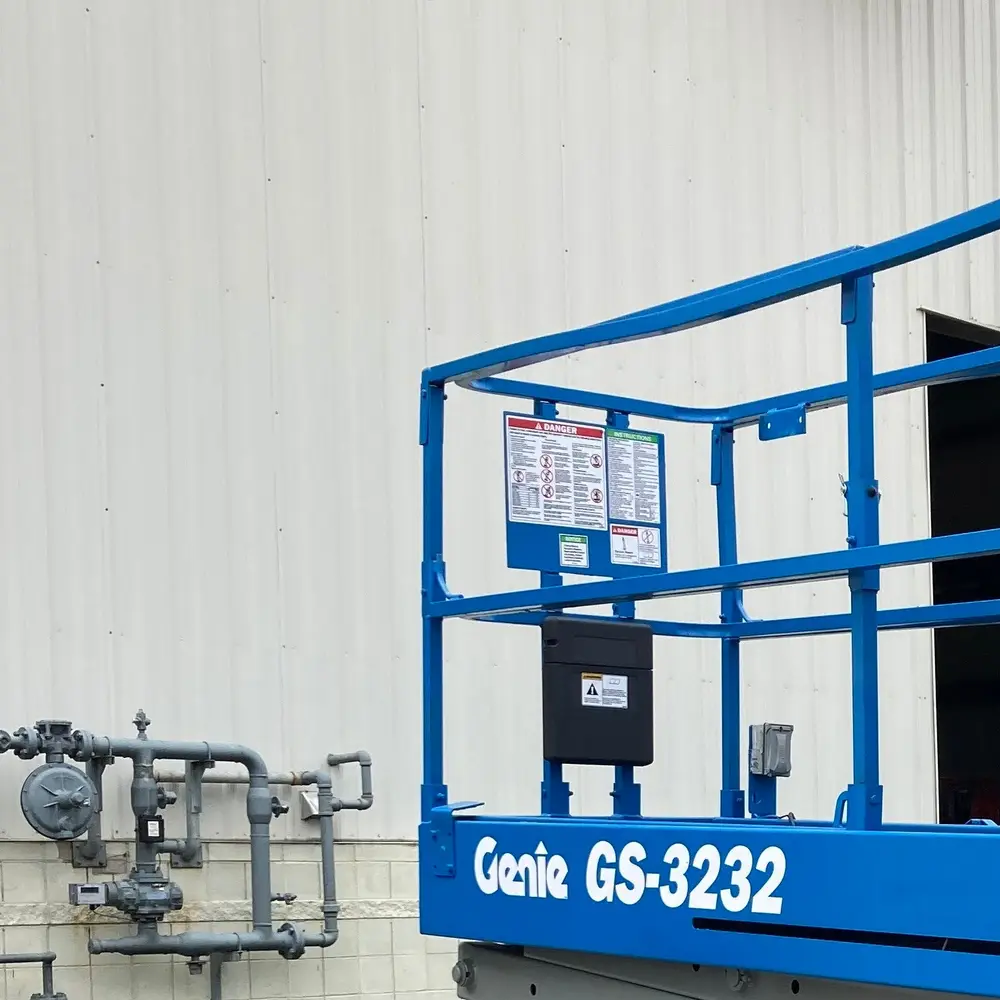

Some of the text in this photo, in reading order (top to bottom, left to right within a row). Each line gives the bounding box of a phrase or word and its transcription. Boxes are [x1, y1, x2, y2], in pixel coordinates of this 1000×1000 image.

[544, 423, 577, 434] DANGER
[613, 431, 652, 442] INSTRUCTIONS
[474, 836, 787, 915] Genie GS-3232
